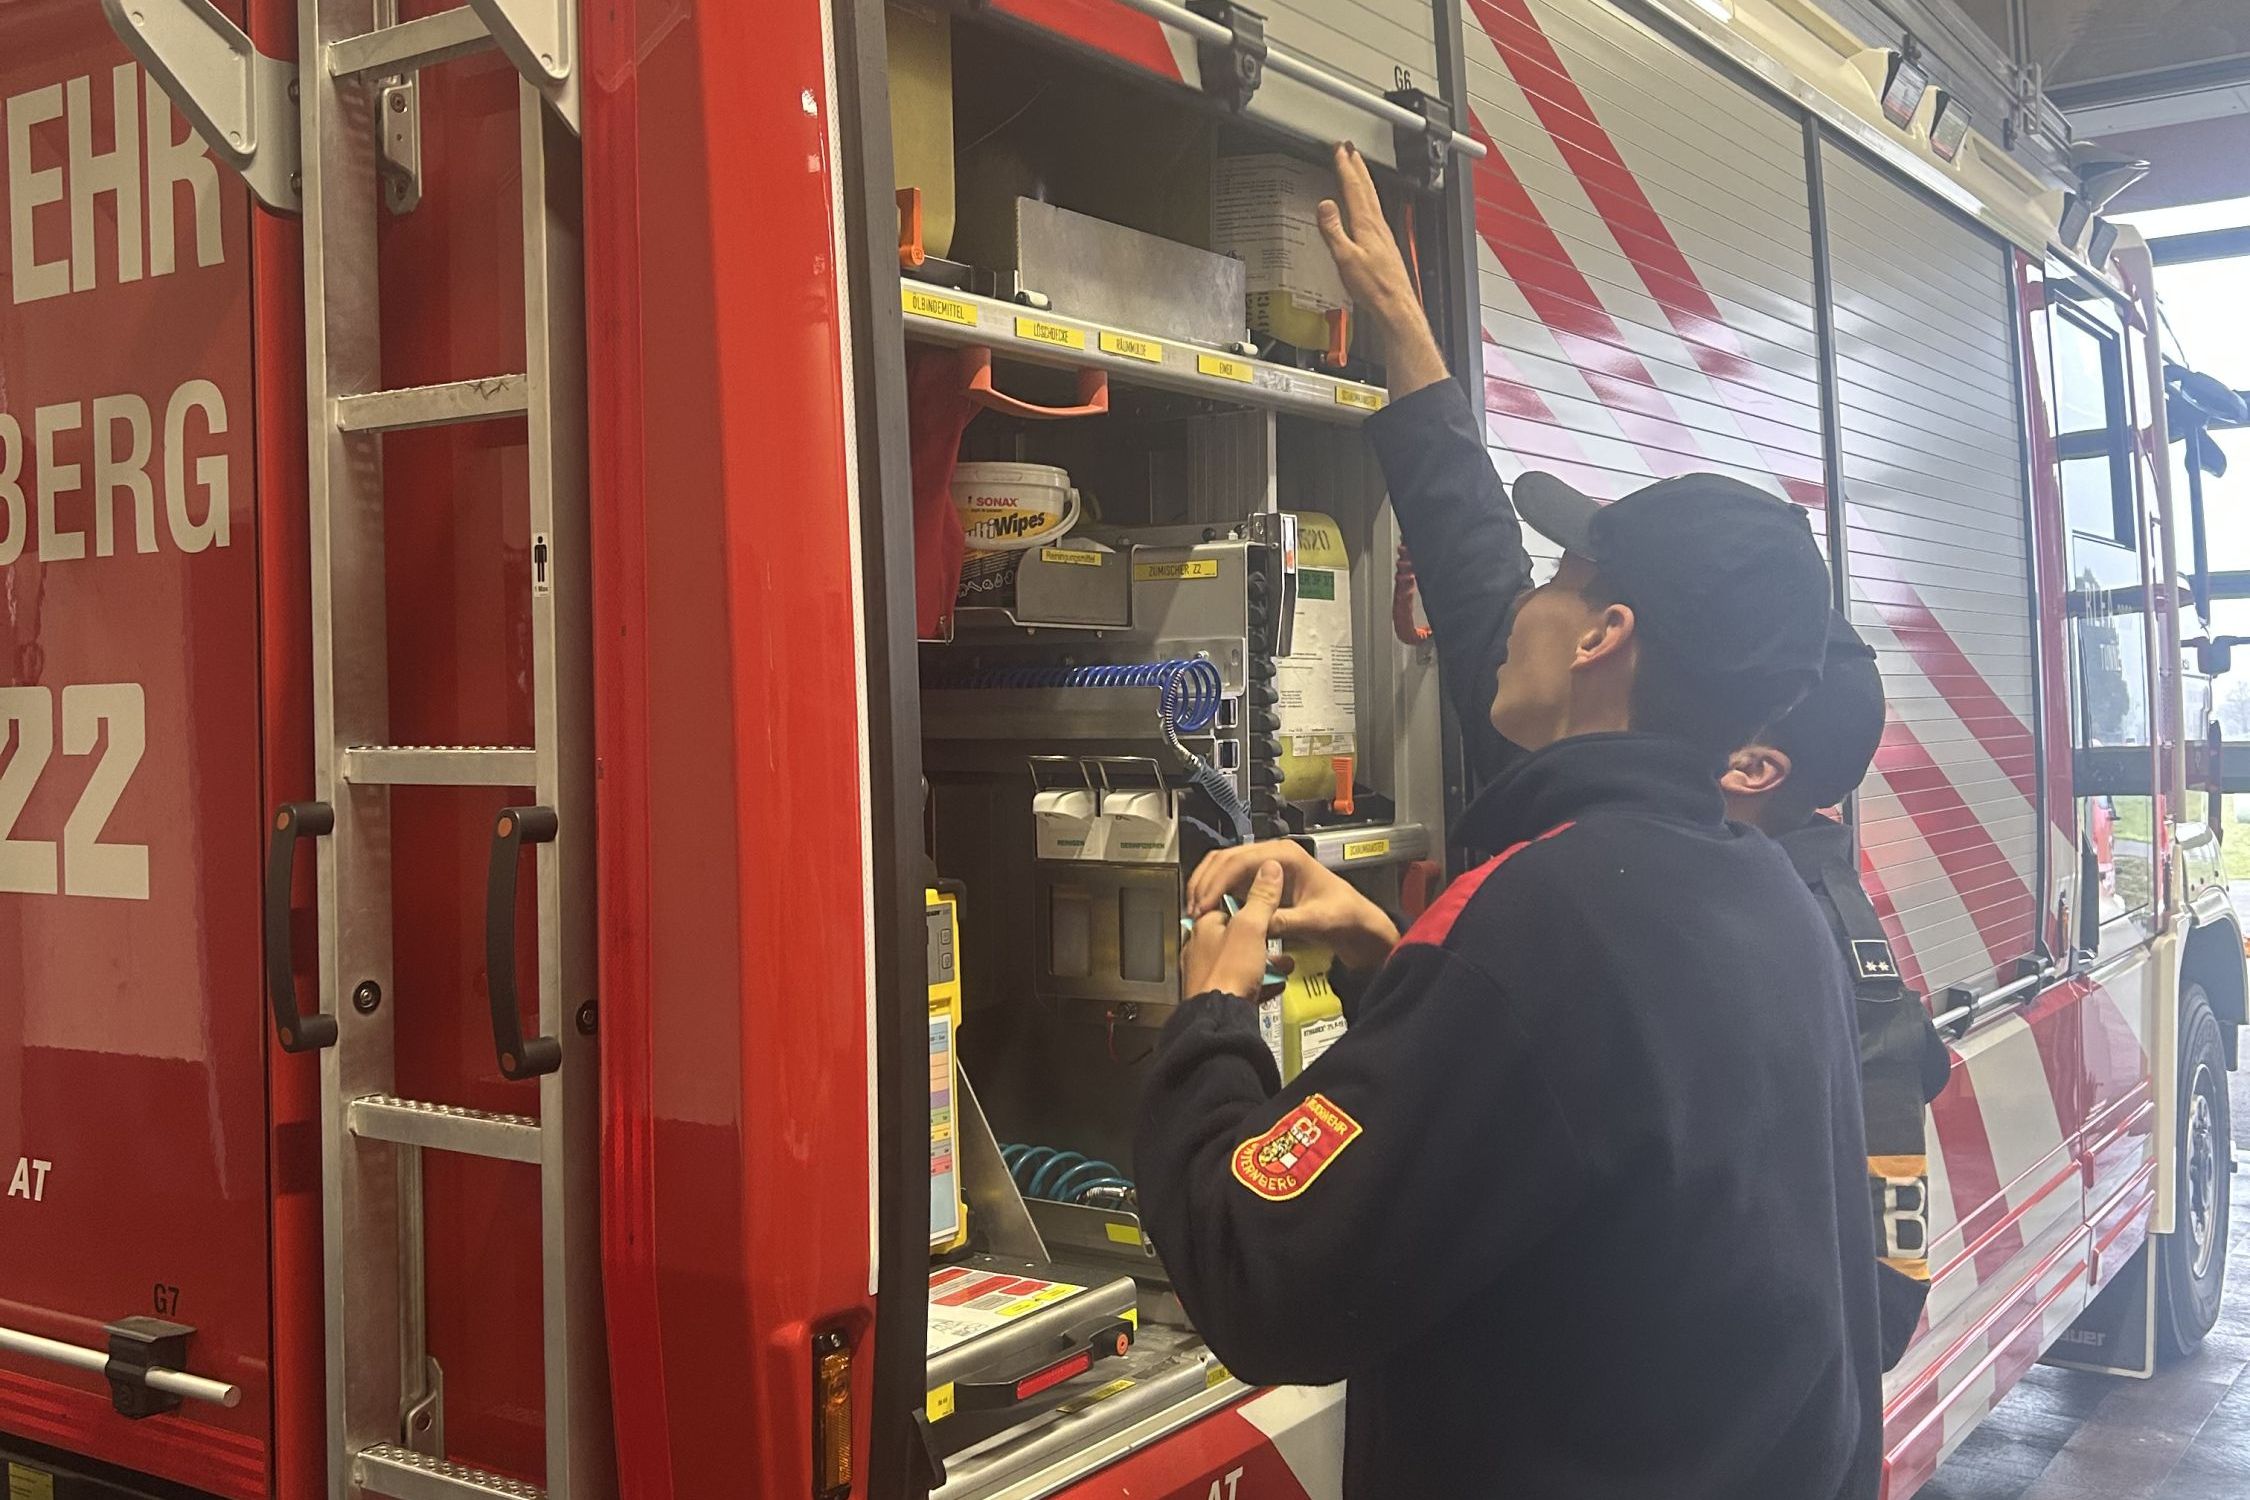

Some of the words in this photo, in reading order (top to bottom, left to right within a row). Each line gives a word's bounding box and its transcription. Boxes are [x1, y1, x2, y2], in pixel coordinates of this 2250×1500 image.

[1395, 66, 1411, 90] G6
[7, 61, 225, 304] EHR
[912, 293, 965, 320] ÖLBINDEMITTEL
[976, 496, 1019, 507] SONAX
[1149, 563, 1189, 577] ZUMISCHER
[0, 683, 149, 900] 22
[8, 1157, 52, 1202] AT
[154, 1283, 179, 1316] G7
[1208, 1465, 1244, 1500] AT
